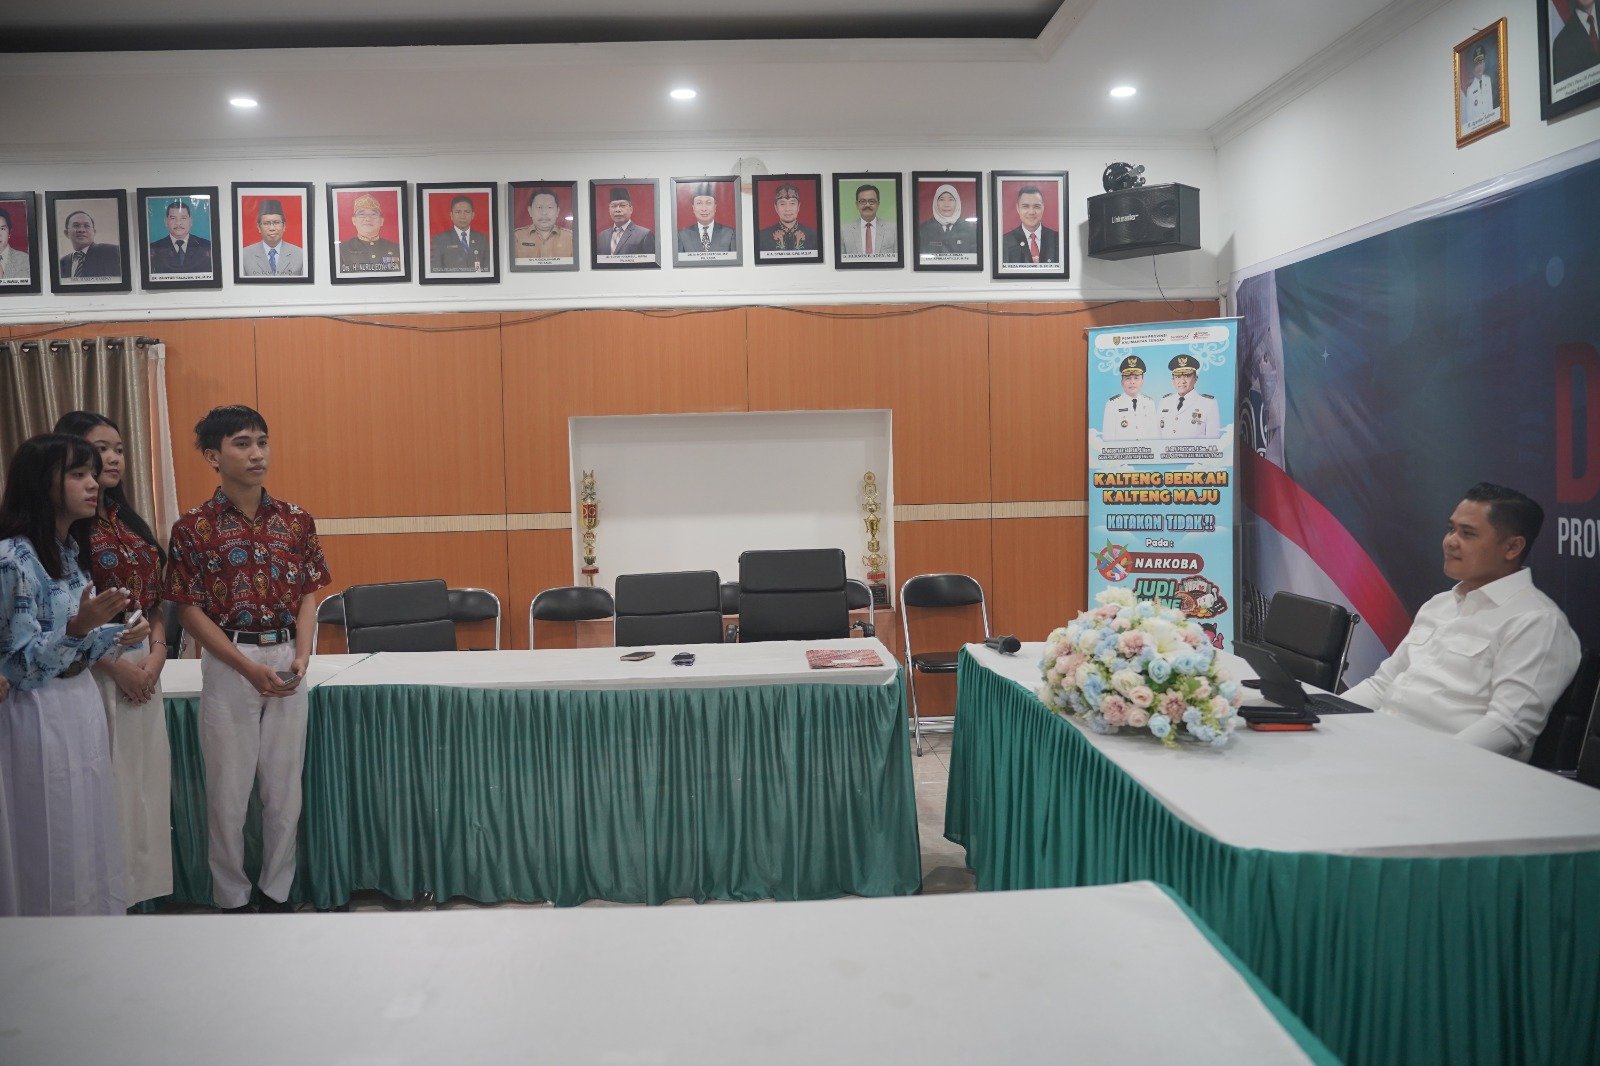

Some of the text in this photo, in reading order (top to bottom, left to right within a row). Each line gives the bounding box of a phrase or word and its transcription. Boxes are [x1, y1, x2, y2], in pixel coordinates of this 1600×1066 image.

[1094, 471, 1228, 488] KALTENG BERKAH
[1103, 489, 1220, 505] KALTENG MAJU
[1107, 514, 1164, 531] KATAKAN
[1558, 517, 1600, 558] PRO
[1135, 557, 1198, 570] NARKOBA
[1135, 580, 1175, 597] JUDI
